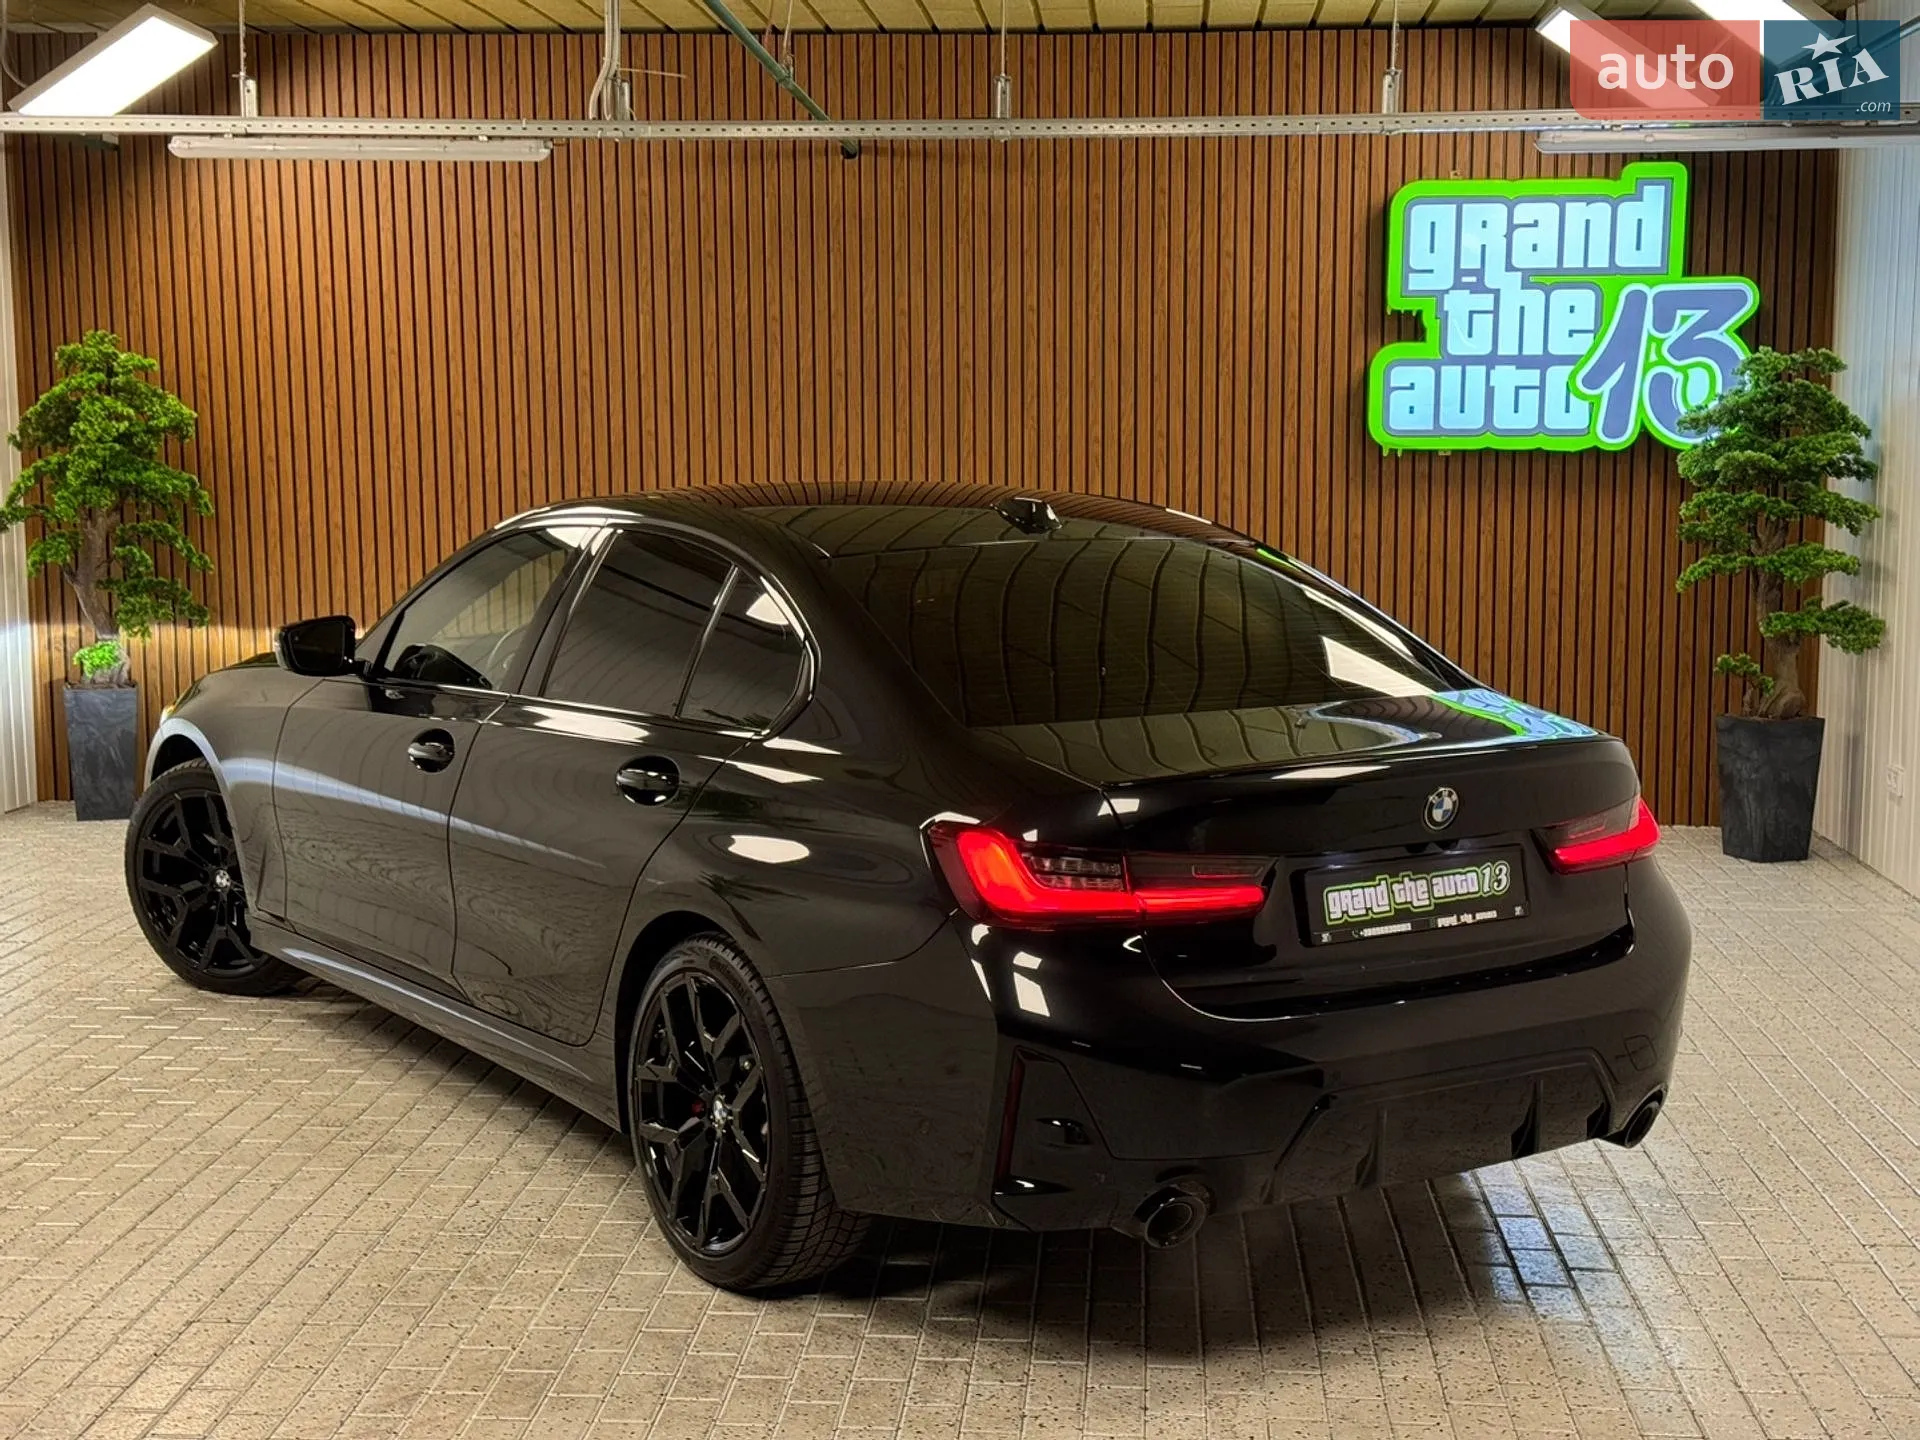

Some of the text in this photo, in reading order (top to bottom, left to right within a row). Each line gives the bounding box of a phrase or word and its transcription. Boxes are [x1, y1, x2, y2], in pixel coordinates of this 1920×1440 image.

[1443, 271, 1597, 356] the
[1388, 282, 1755, 444] auto 13
[1391, 875, 1430, 906] the
[1431, 871, 1479, 898] auto
[1480, 862, 1510, 894] 13
